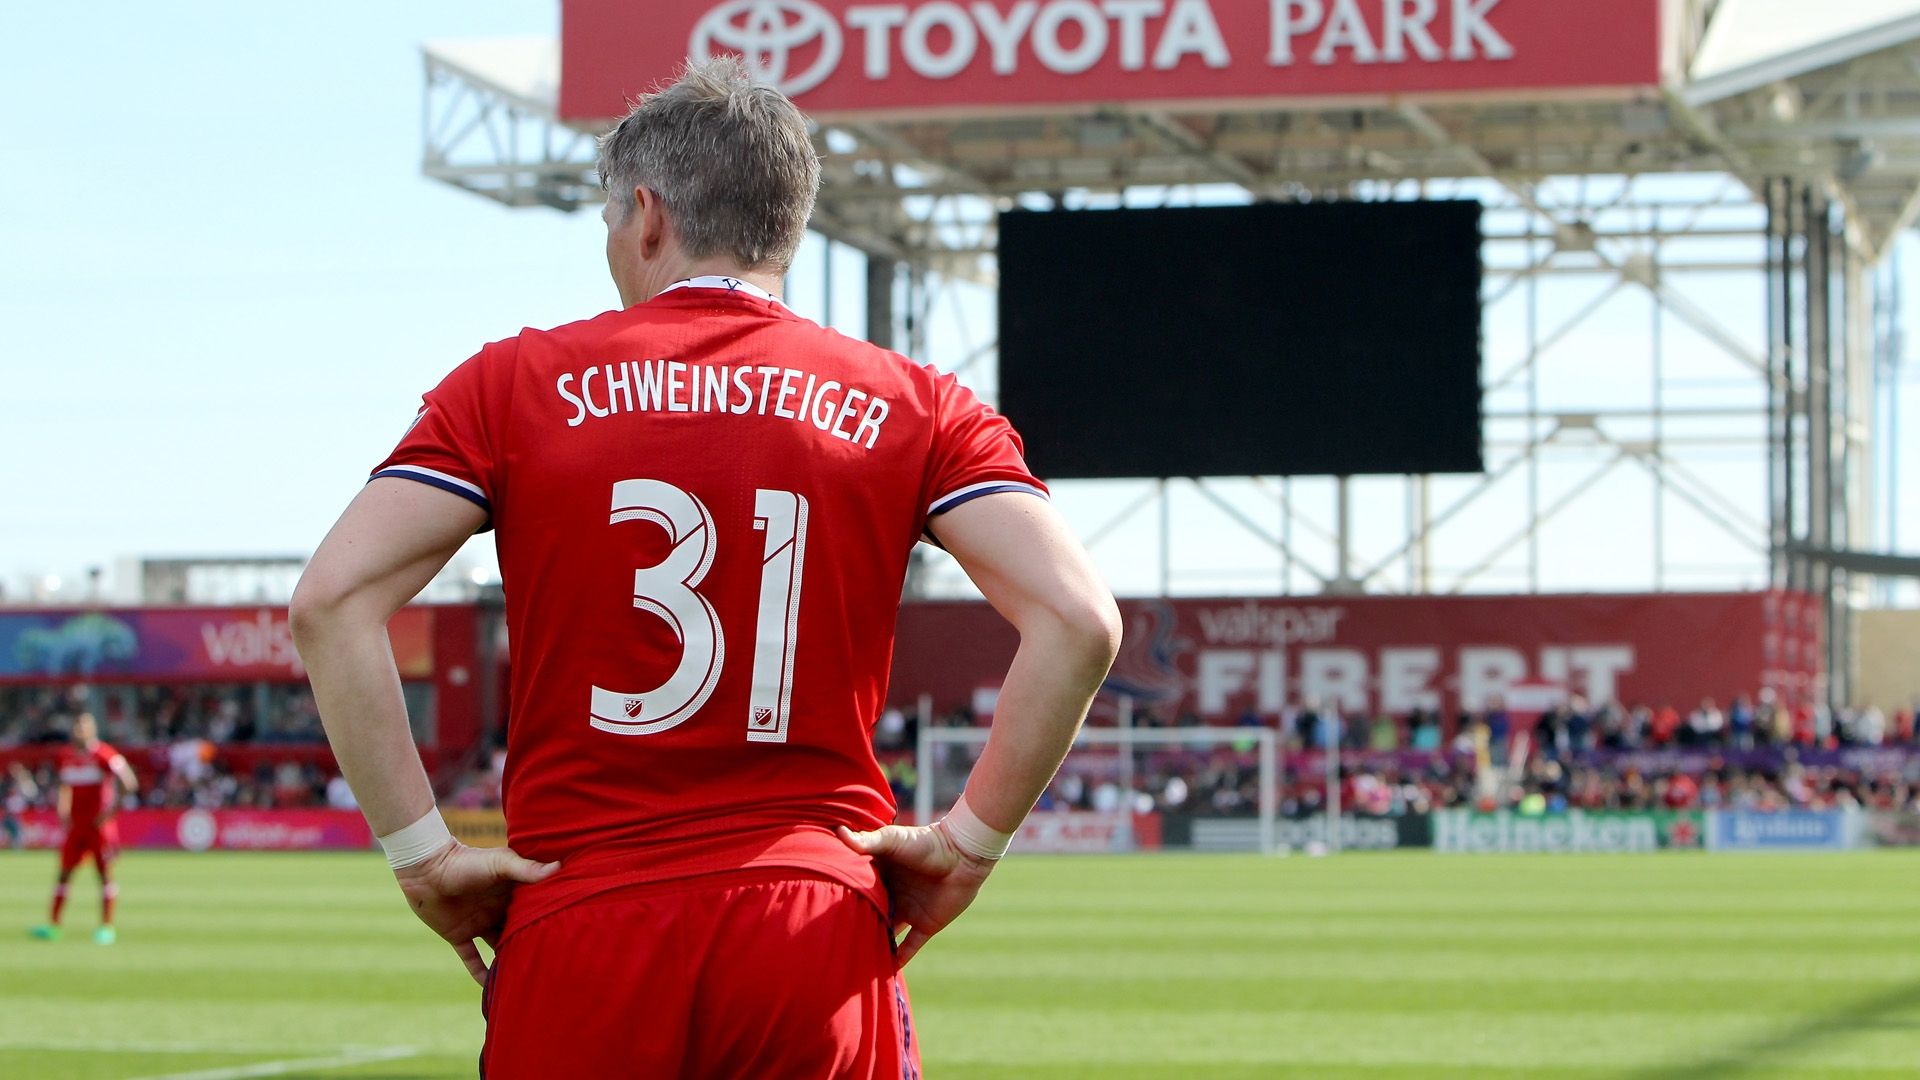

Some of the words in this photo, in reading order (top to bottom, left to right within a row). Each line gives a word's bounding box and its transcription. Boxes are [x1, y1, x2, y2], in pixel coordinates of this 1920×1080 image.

[846, 0, 1230, 78] TOYOTA
[1267, 0, 1515, 66] PARK
[556, 359, 889, 450] SCHWEINSTEIGER
[590, 478, 809, 743] 31
[1433, 808, 1657, 852] Heineken
